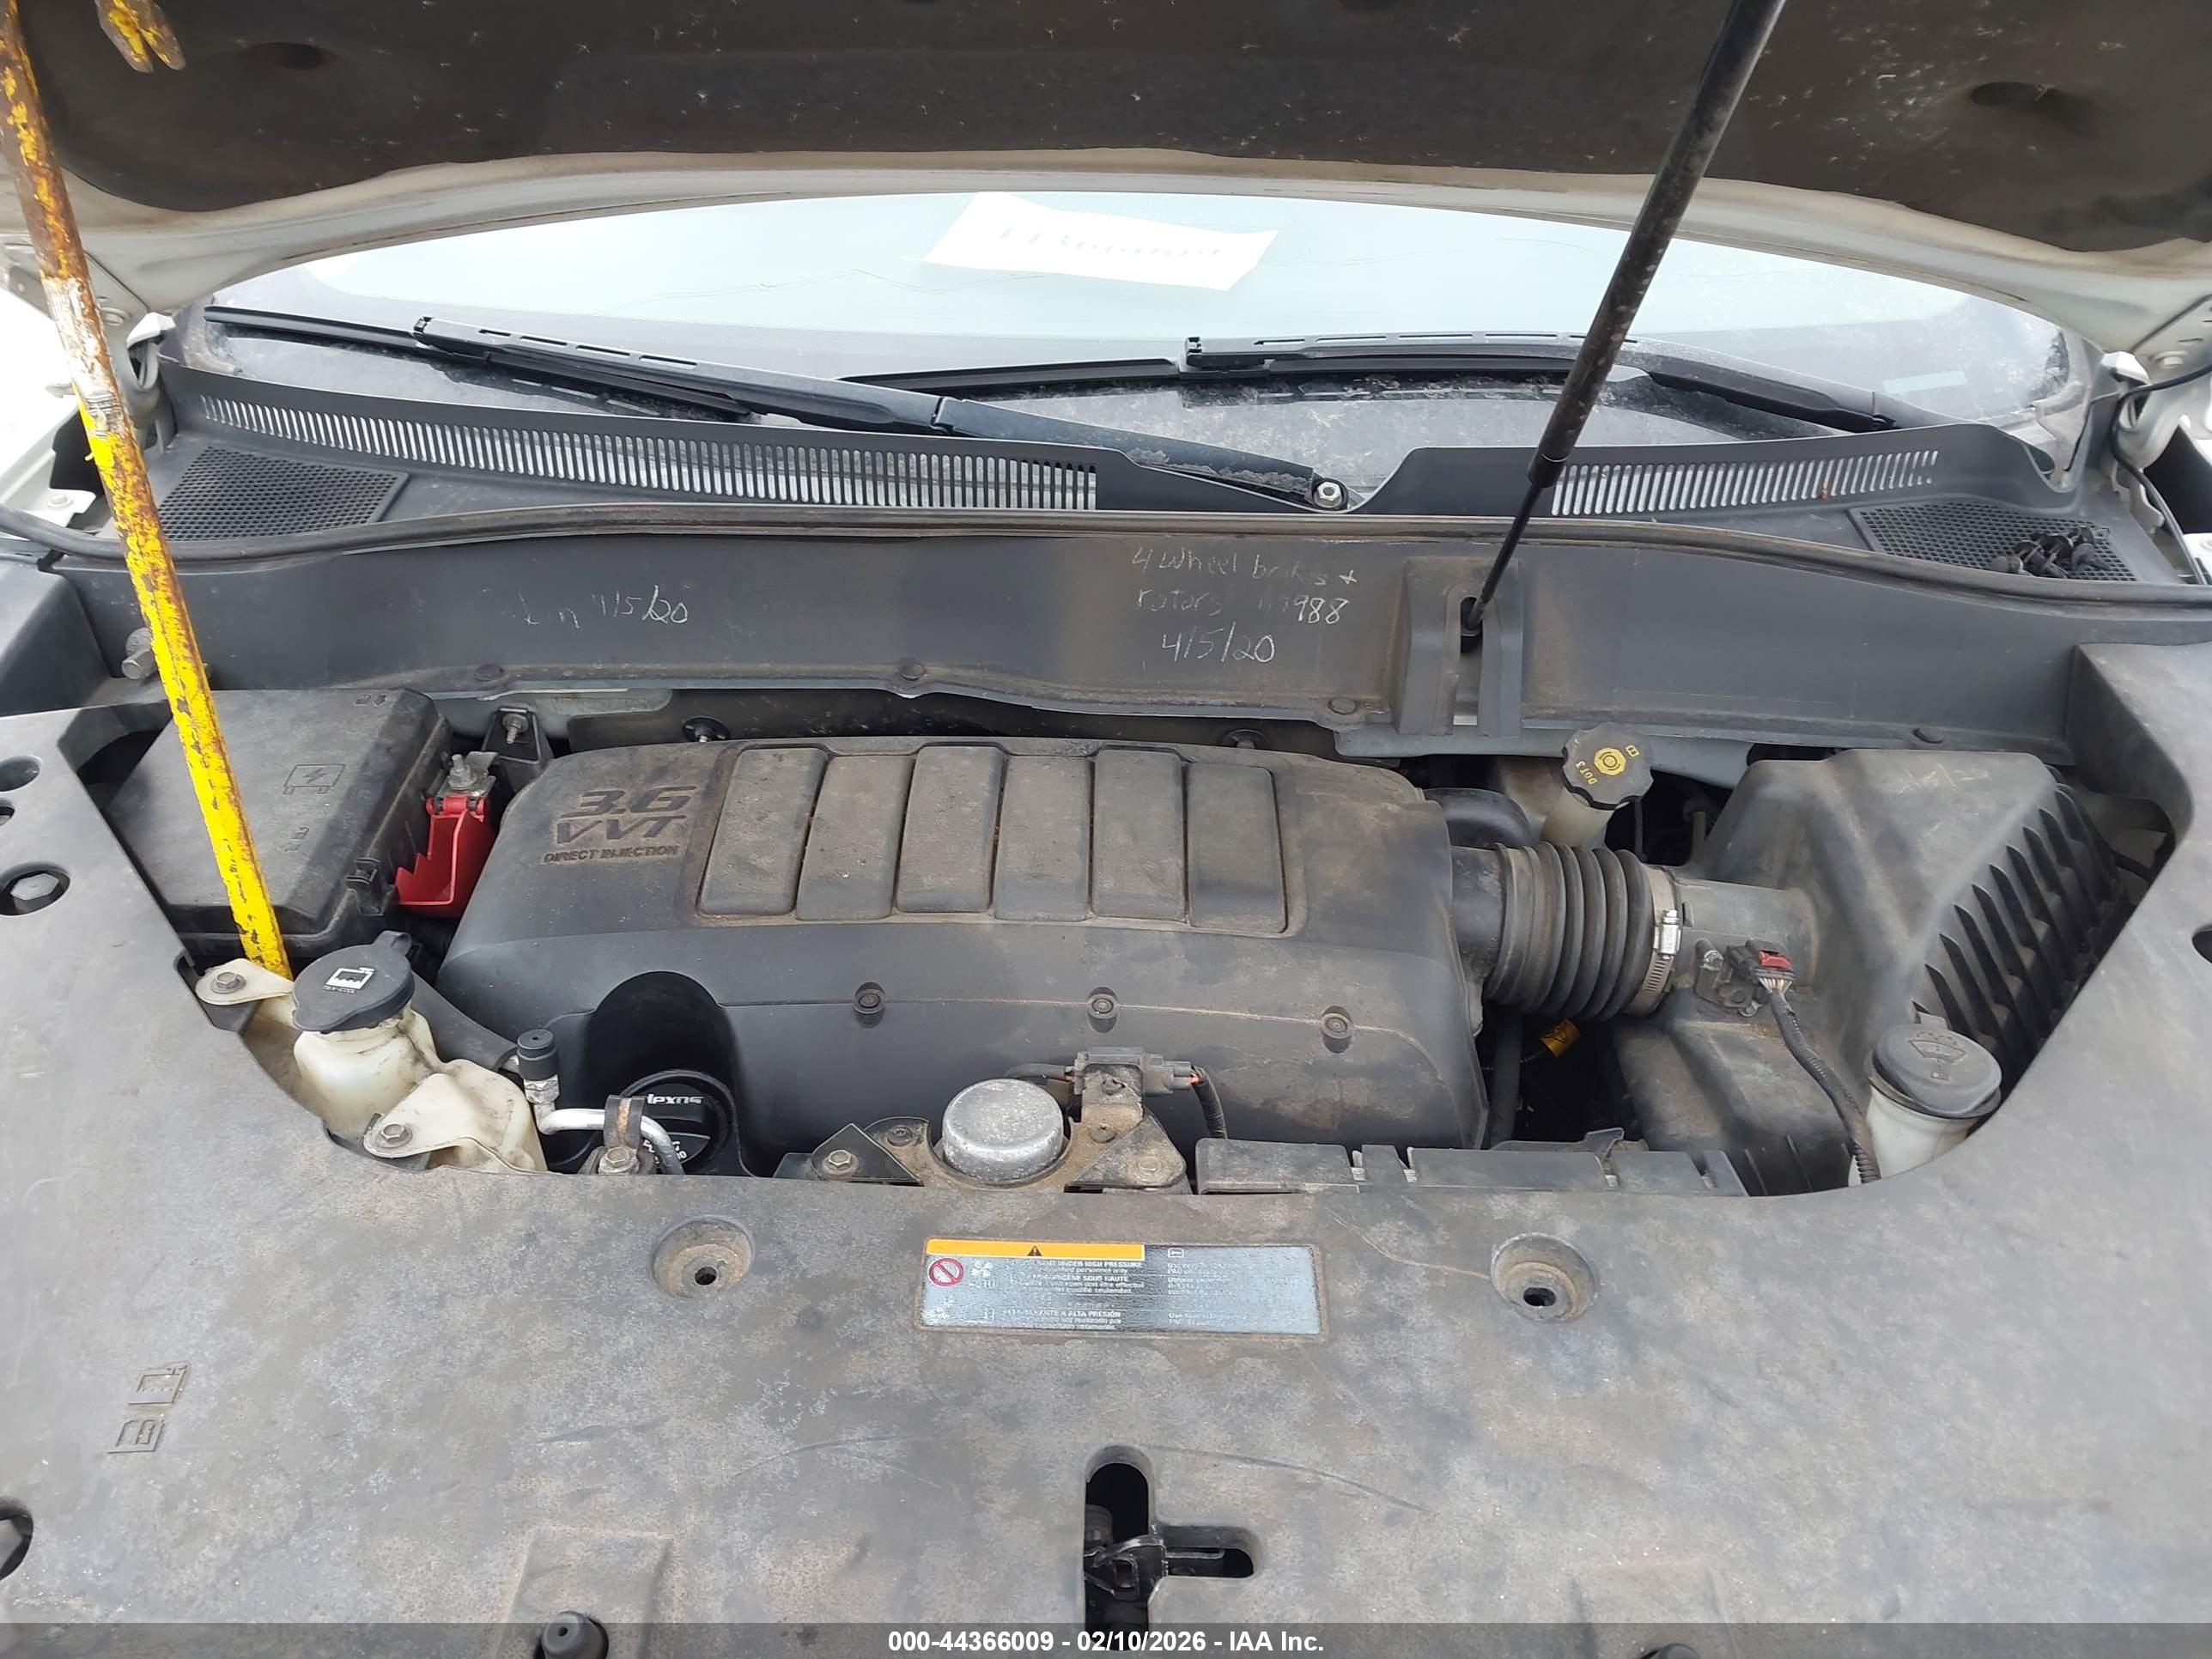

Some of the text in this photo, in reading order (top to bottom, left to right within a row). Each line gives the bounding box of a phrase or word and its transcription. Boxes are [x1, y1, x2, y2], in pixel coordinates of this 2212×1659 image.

[1162, 622, 1276, 663] 4/5/20
[560, 785, 697, 818] 3.6
[557, 815, 687, 845] VVT
[544, 845, 679, 864] DIRECT INJECTION
